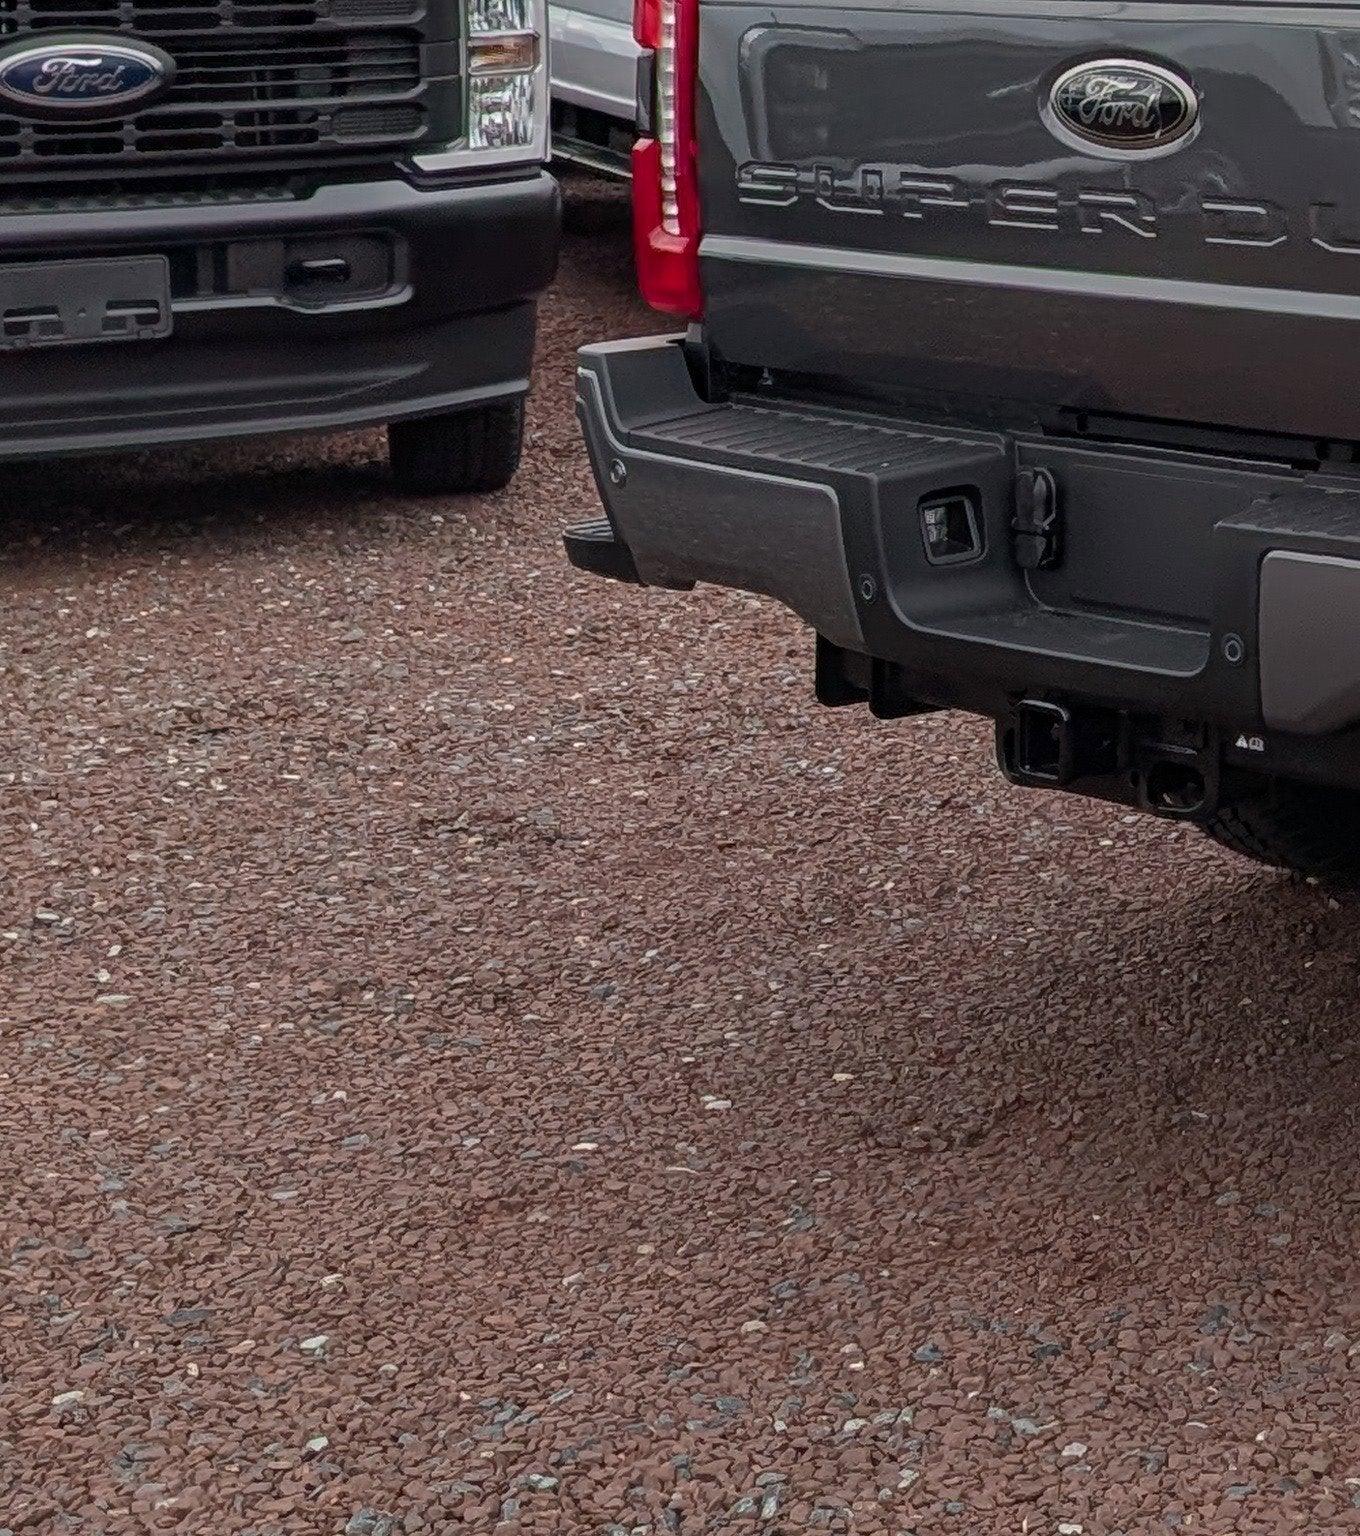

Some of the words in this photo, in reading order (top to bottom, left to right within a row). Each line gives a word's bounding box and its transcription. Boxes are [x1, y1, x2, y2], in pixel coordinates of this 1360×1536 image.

[32, 58, 126, 93] Ford
[1078, 77, 1158, 129] Ford
[736, 160, 1158, 238] SUPER
